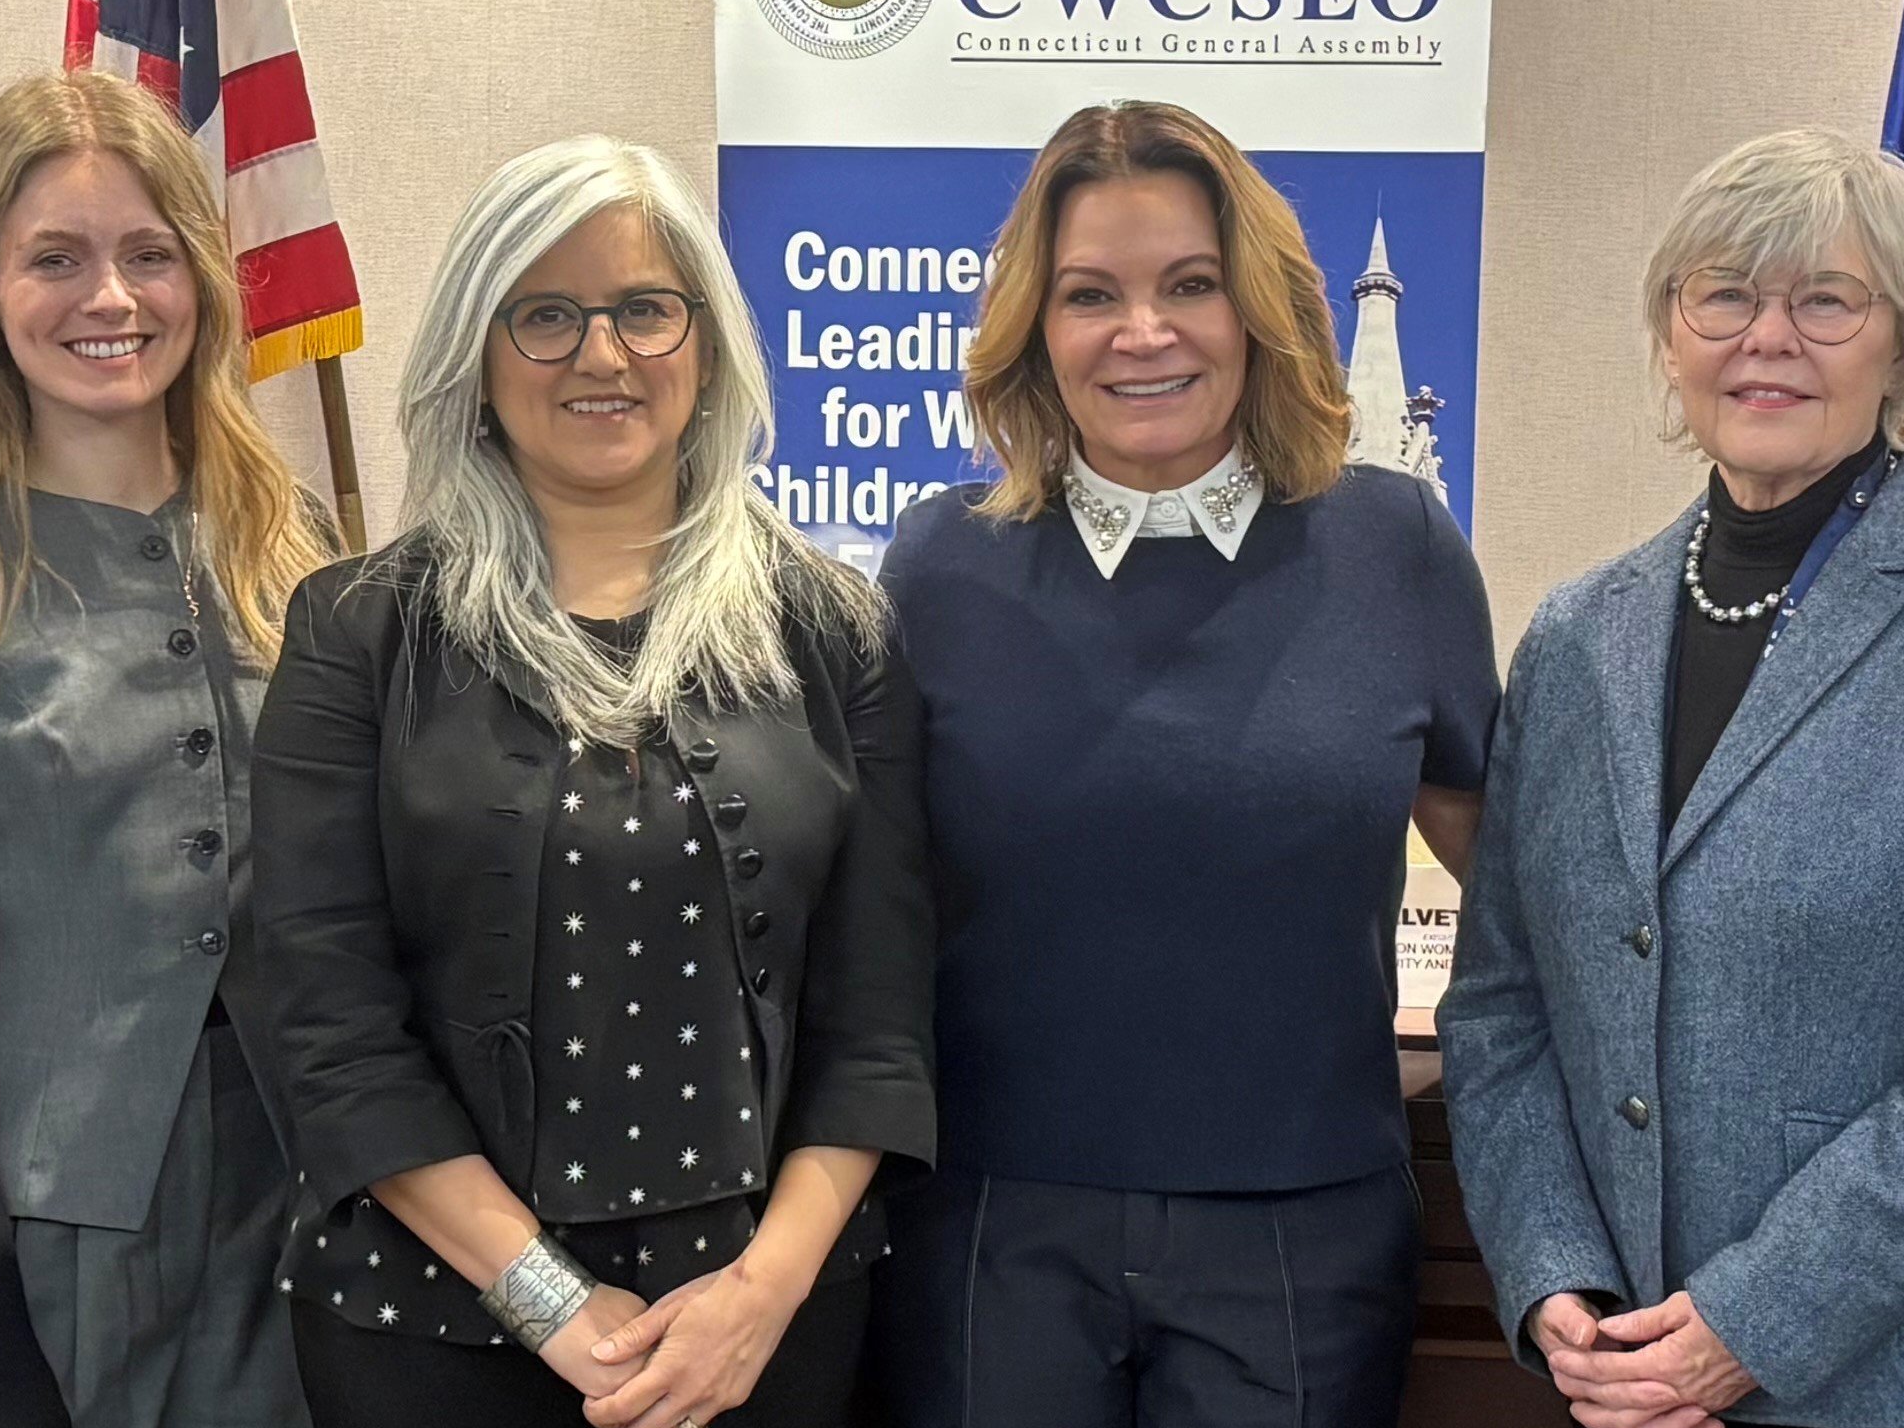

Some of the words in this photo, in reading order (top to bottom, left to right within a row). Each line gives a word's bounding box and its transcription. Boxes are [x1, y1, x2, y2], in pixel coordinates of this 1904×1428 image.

[956, 32, 1143, 52] Connecticut
[1161, 33, 1280, 54] General
[1298, 34, 1441, 59] Assembly
[821, 385, 911, 449] for
